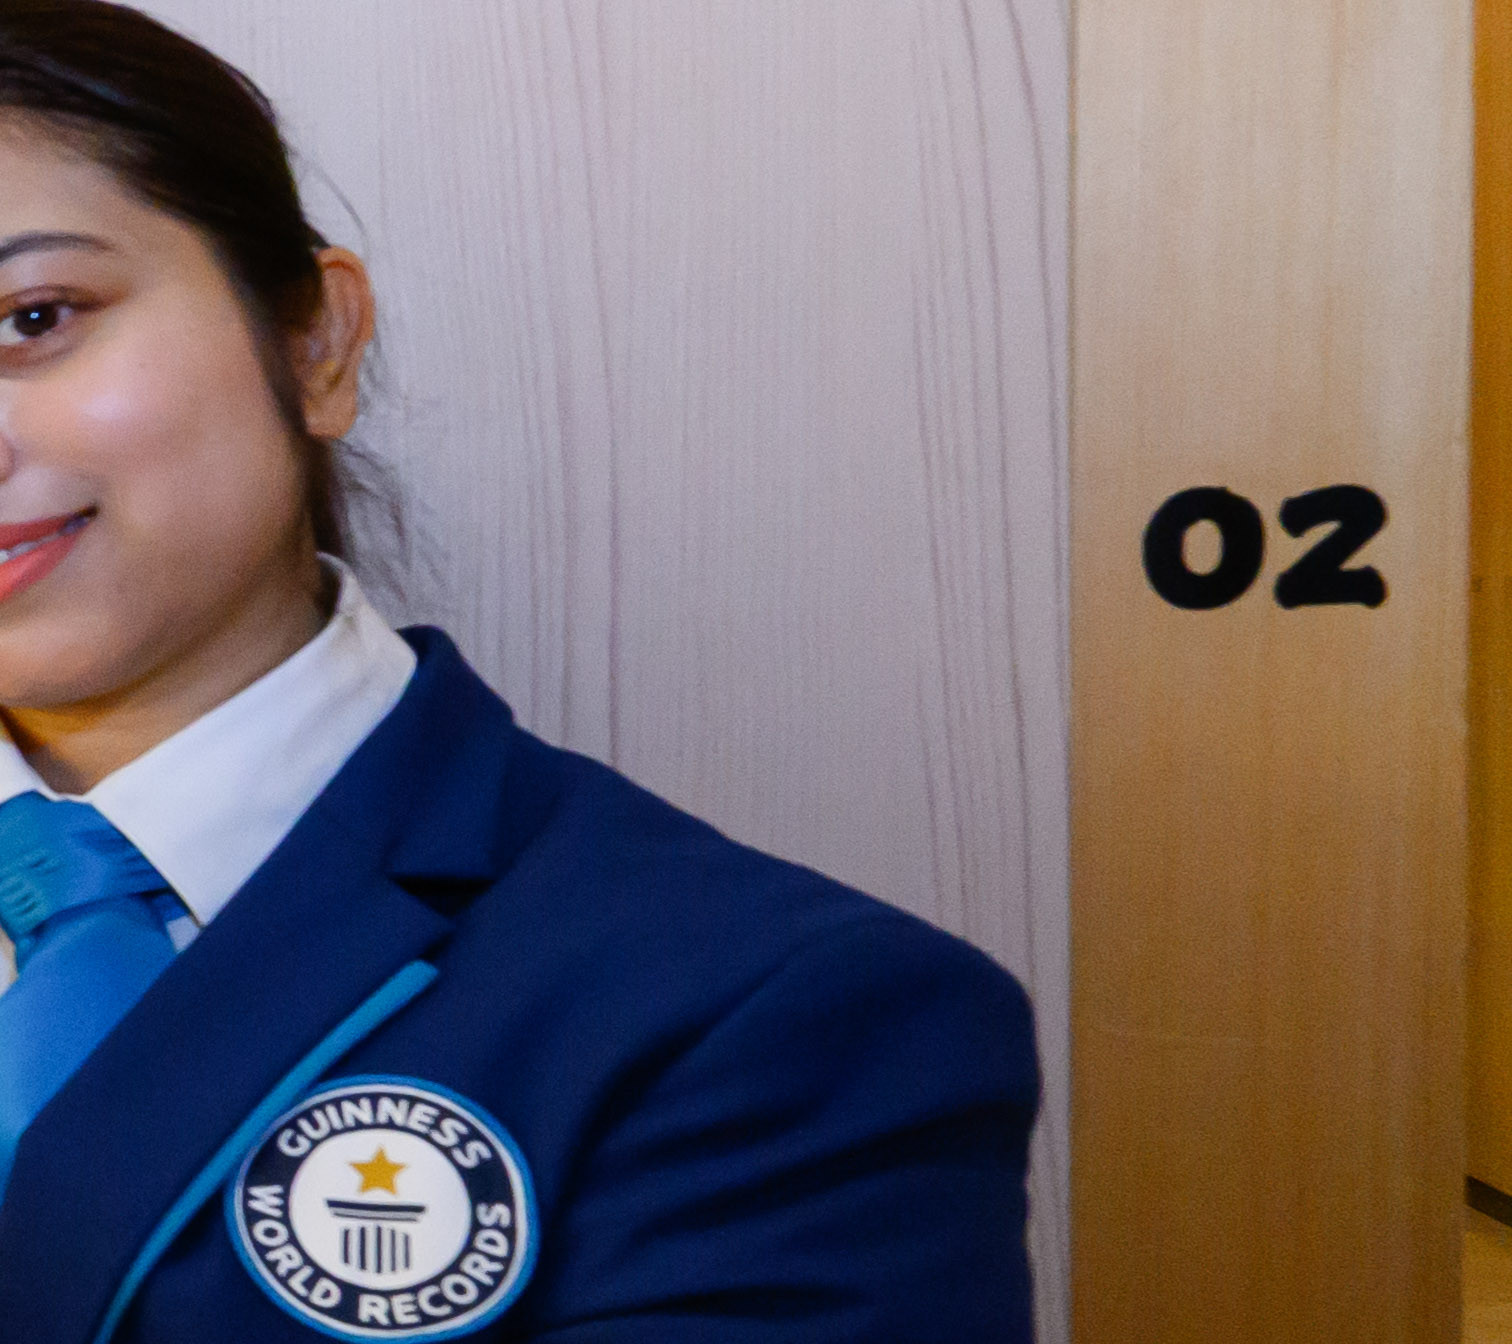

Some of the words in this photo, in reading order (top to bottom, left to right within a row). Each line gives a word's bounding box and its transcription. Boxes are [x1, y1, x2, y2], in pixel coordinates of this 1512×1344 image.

[1141, 483, 1389, 611] 02
[277, 1097, 493, 1169] GUINNESS
[248, 1184, 342, 1309] WORLD
[357, 1201, 512, 1327] RECORDS
